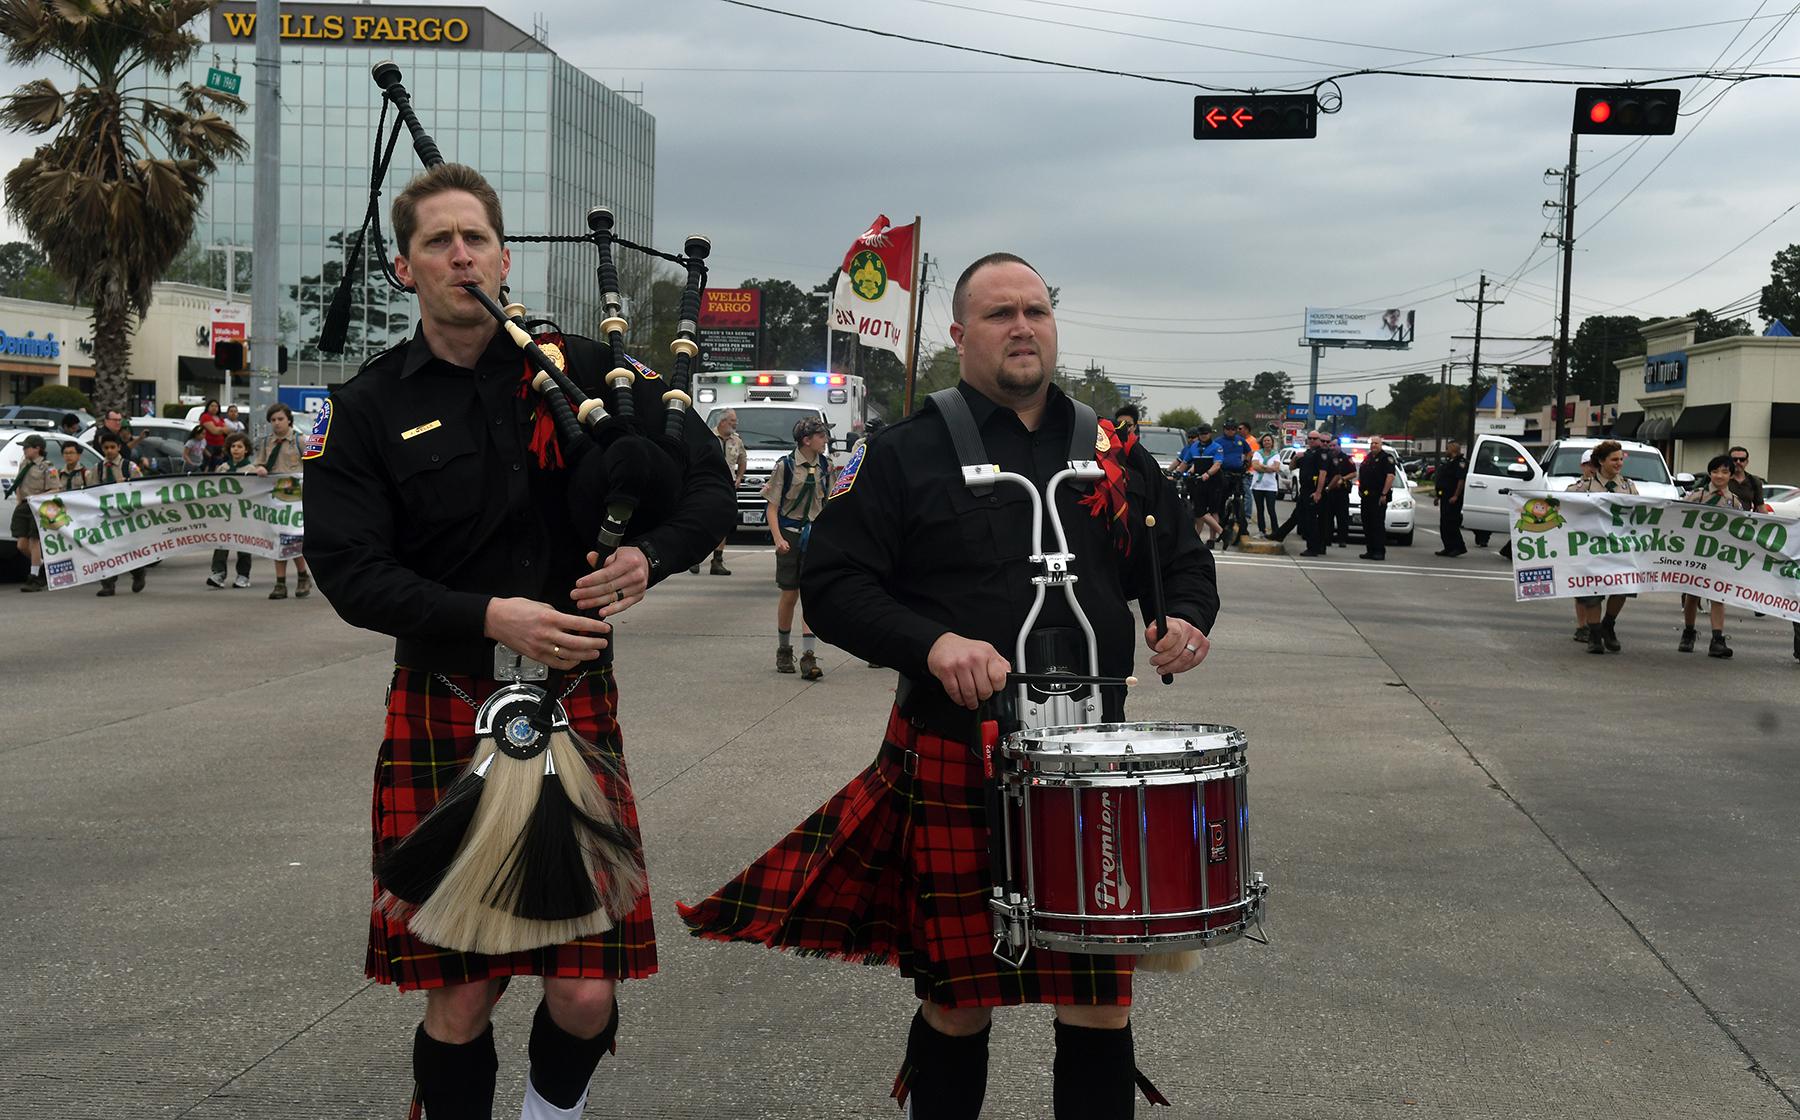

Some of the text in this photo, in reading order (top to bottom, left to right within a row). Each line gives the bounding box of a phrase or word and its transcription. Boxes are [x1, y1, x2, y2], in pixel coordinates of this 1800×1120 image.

[224, 12, 470, 42] WLLS FARGO
[211, 72, 237, 91] FM 1960
[707, 292, 752, 302] WELLS
[708, 302, 751, 312] FARGO
[1318, 396, 1353, 411] IHOP
[44, 498, 304, 556] St. Patrick's Day Parade
[1610, 503, 1788, 553] FM 1960
[82, 546, 151, 576] SUPPORTING
[151, 539, 175, 553] THE
[176, 532, 218, 547] MEDICS
[219, 532, 233, 544] OF
[1516, 534, 1558, 561] St.
[1567, 527, 1686, 557] Patrick's
[1694, 534, 1756, 571] Day
[1684, 560, 1708, 570] 1978
[1568, 571, 1800, 614] SUPPORTING THE MEDICS OF TOMORRO
[1094, 791, 1116, 910] Premier
